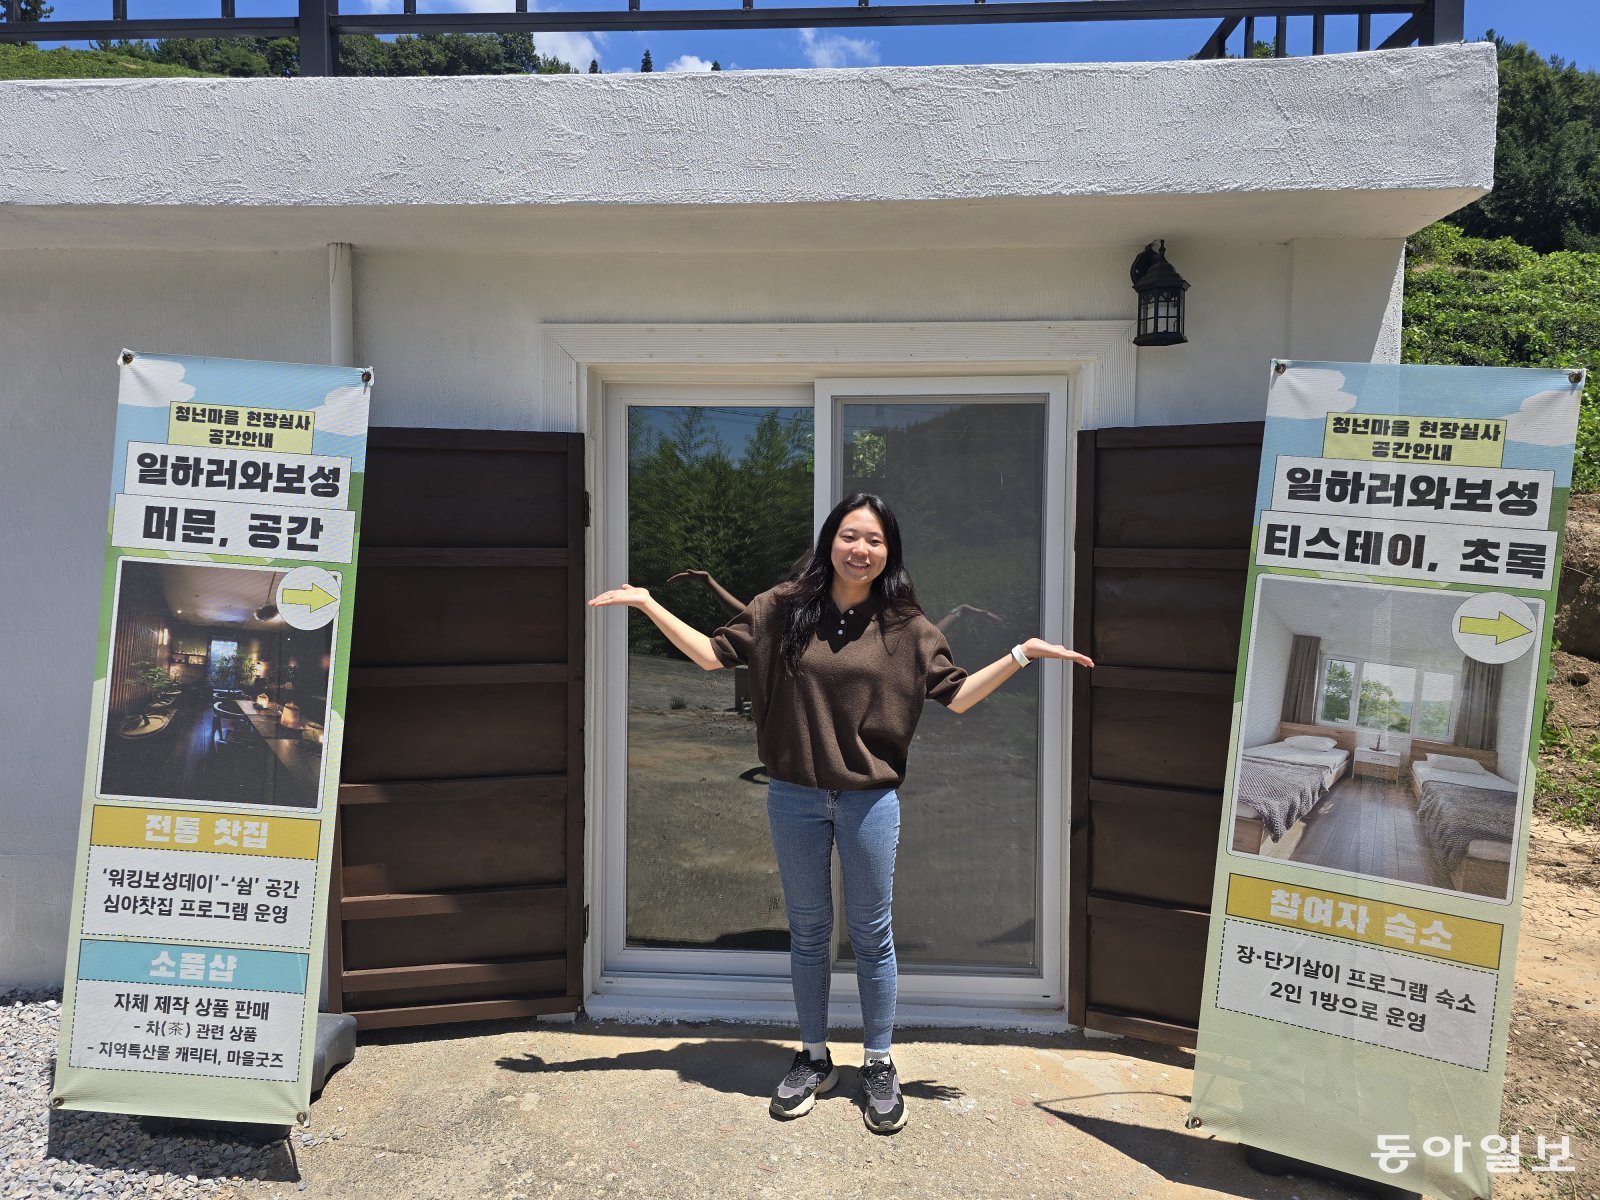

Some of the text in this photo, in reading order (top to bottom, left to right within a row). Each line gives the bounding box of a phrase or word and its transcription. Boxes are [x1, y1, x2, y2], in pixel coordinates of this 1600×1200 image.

[175, 406, 311, 431] 청년마을 현장실사
[1332, 417, 1501, 442] 청년마을 현장실사
[209, 429, 273, 448] 공간안내
[1372, 441, 1452, 461] 공간안내
[137, 452, 341, 498] 일하러와보성
[1286, 467, 1540, 516] 일하러와보성
[142, 505, 323, 552] 머문, 공간
[1264, 523, 1547, 579] 티스테이, 초록
[145, 814, 268, 849] 전통 찻집
[266, 878, 299, 899] 공간
[103, 894, 288, 924] 심야찻집 프로그램 운영
[1269, 888, 1453, 951] 참여자 숙소
[150, 951, 237, 983] 소품샵
[1346, 968, 1428, 1004] 프로그램
[1435, 988, 1476, 1014] 숙소
[113, 993, 270, 1021] 자체 제작 상품 판매
[1270, 981, 1426, 1033] 2인 1방으로 운영
[145, 1021, 191, 1037] 차(茶)
[196, 1024, 224, 1040] 관련
[229, 1026, 258, 1042] 상품
[98, 1041, 170, 1061] 지역특산물
[175, 1046, 221, 1066] 캐릭터,
[227, 1049, 283, 1069] 마을굿즈
